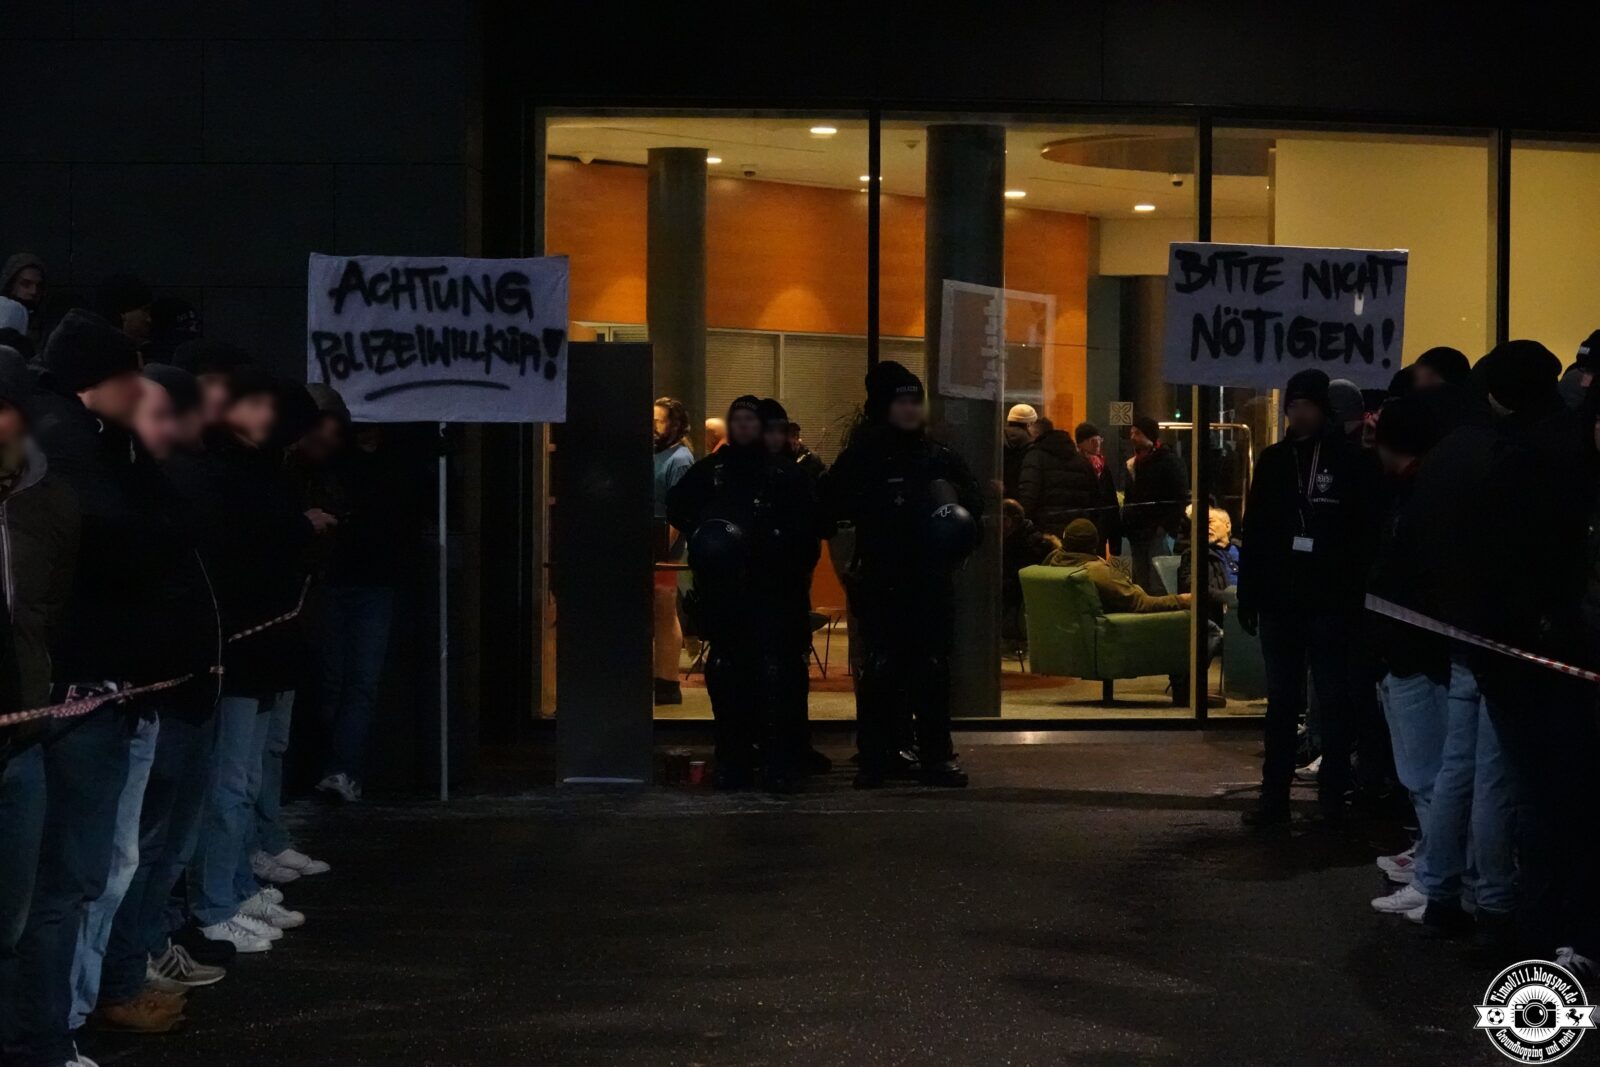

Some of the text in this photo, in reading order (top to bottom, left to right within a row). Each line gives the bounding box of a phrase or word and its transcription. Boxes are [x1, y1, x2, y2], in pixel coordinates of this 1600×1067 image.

[327, 259, 535, 323] ACHTUNG
[1174, 249, 1408, 301] BITTE NICHT
[1190, 303, 1395, 370] NÖTIGEN!
